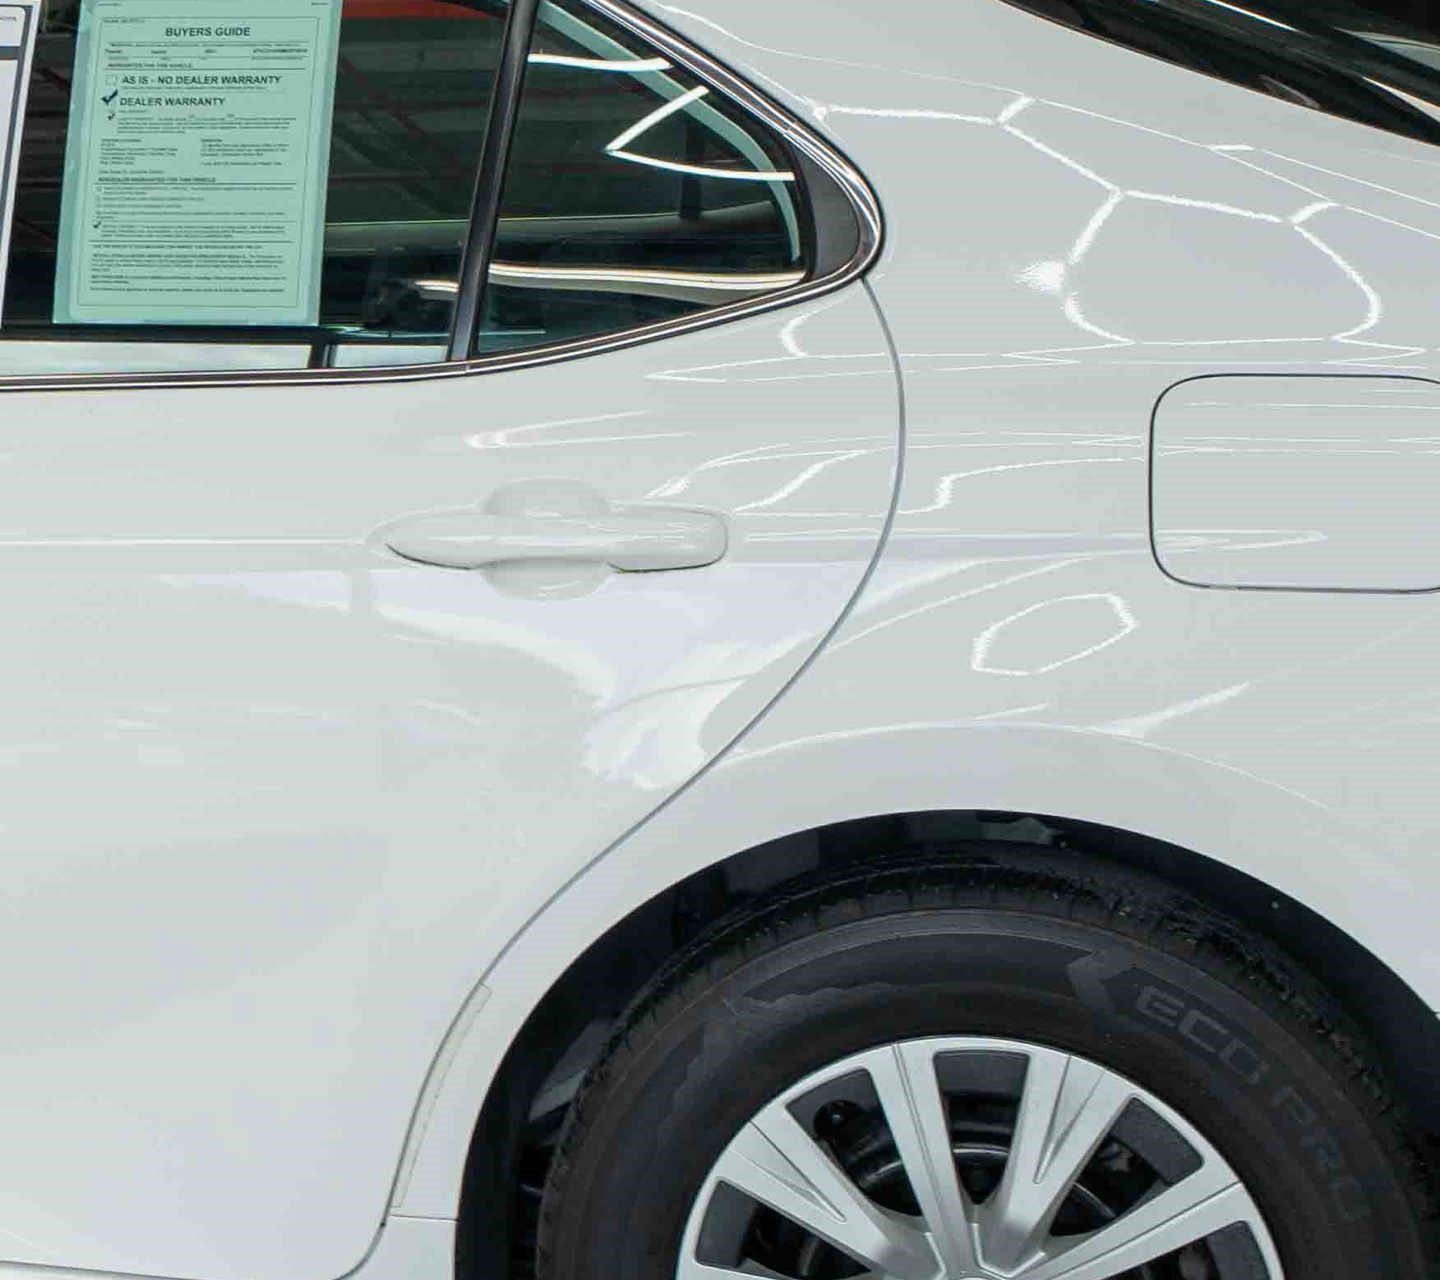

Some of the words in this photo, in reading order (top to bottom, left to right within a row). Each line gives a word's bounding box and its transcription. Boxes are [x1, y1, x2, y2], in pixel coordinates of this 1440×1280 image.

[165, 27, 212, 37] BUYERS
[215, 26, 251, 37] GUIDE
[122, 75, 136, 85] AS
[139, 75, 149, 85] IS
[158, 75, 173, 85] NO
[175, 75, 218, 85] DEALER
[221, 75, 282, 85] WARRANTY
[120, 97, 162, 106] DEALER
[165, 97, 225, 106] WARRANTY
[1136, 983, 1270, 1086] ECO
